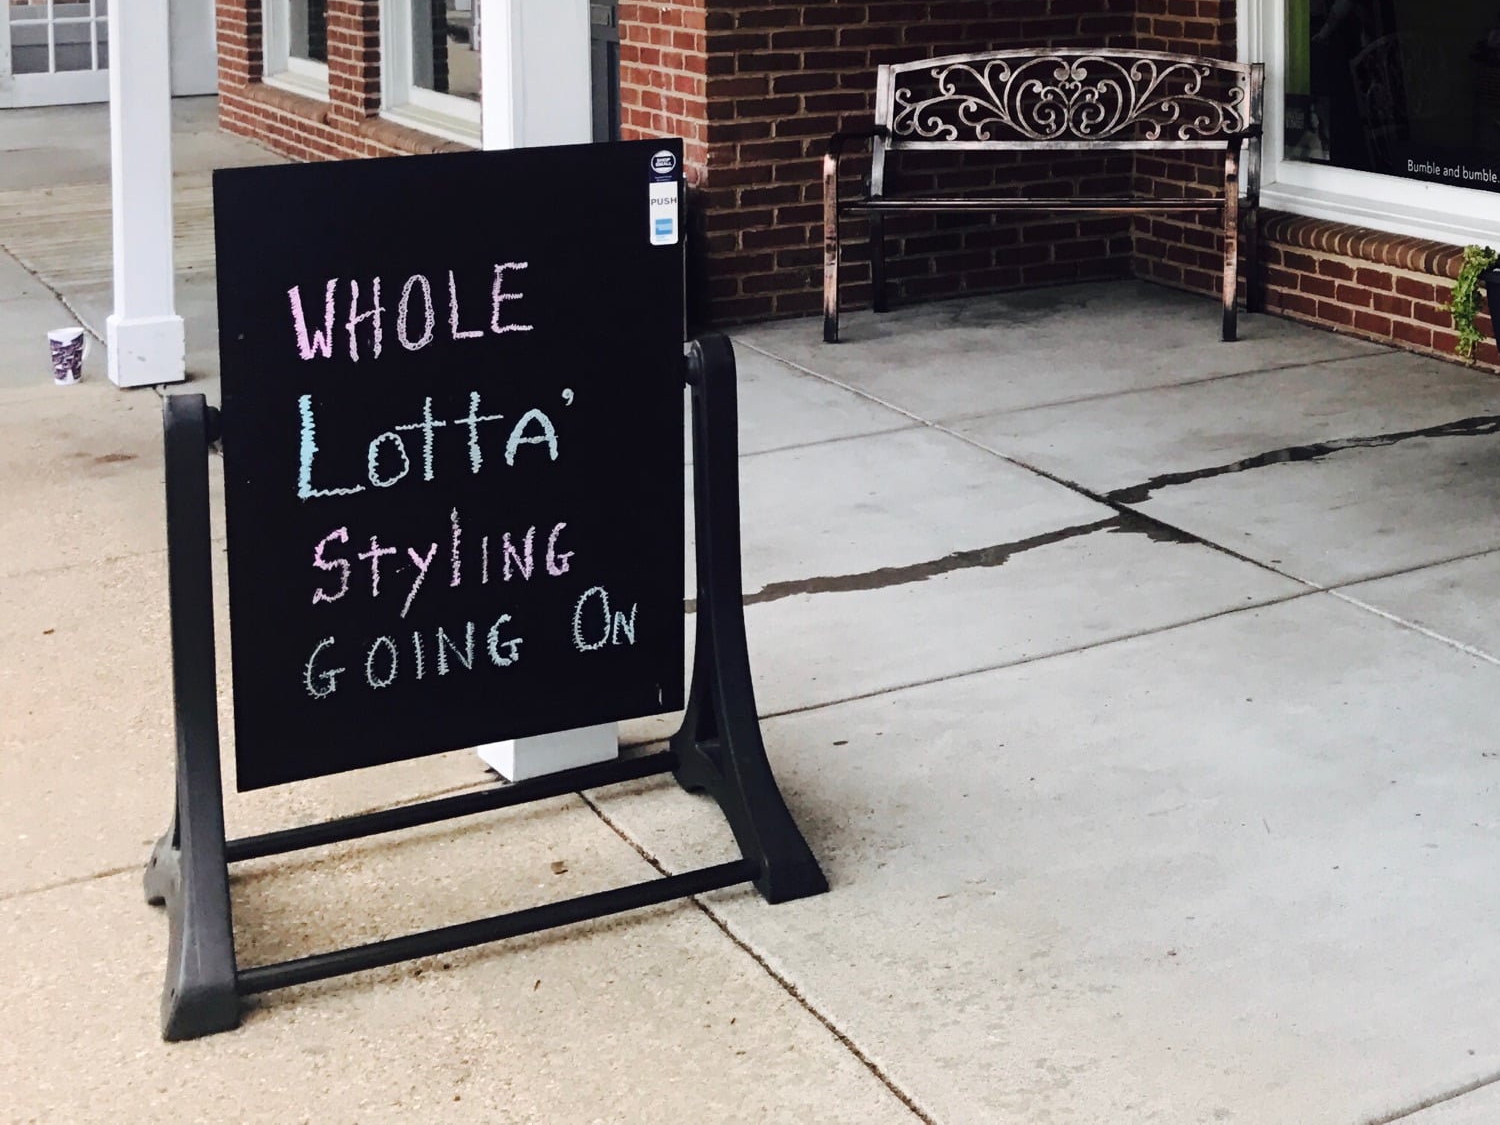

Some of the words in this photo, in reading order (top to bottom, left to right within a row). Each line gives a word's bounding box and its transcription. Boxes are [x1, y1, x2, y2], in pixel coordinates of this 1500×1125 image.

[1407, 159, 1441, 176] Bumble
[1442, 165, 1460, 178] and
[1462, 165, 1500, 183] bumble.
[650, 196, 678, 206] PUSH
[287, 261, 533, 362] WHOLE
[303, 613, 524, 699] GOING
